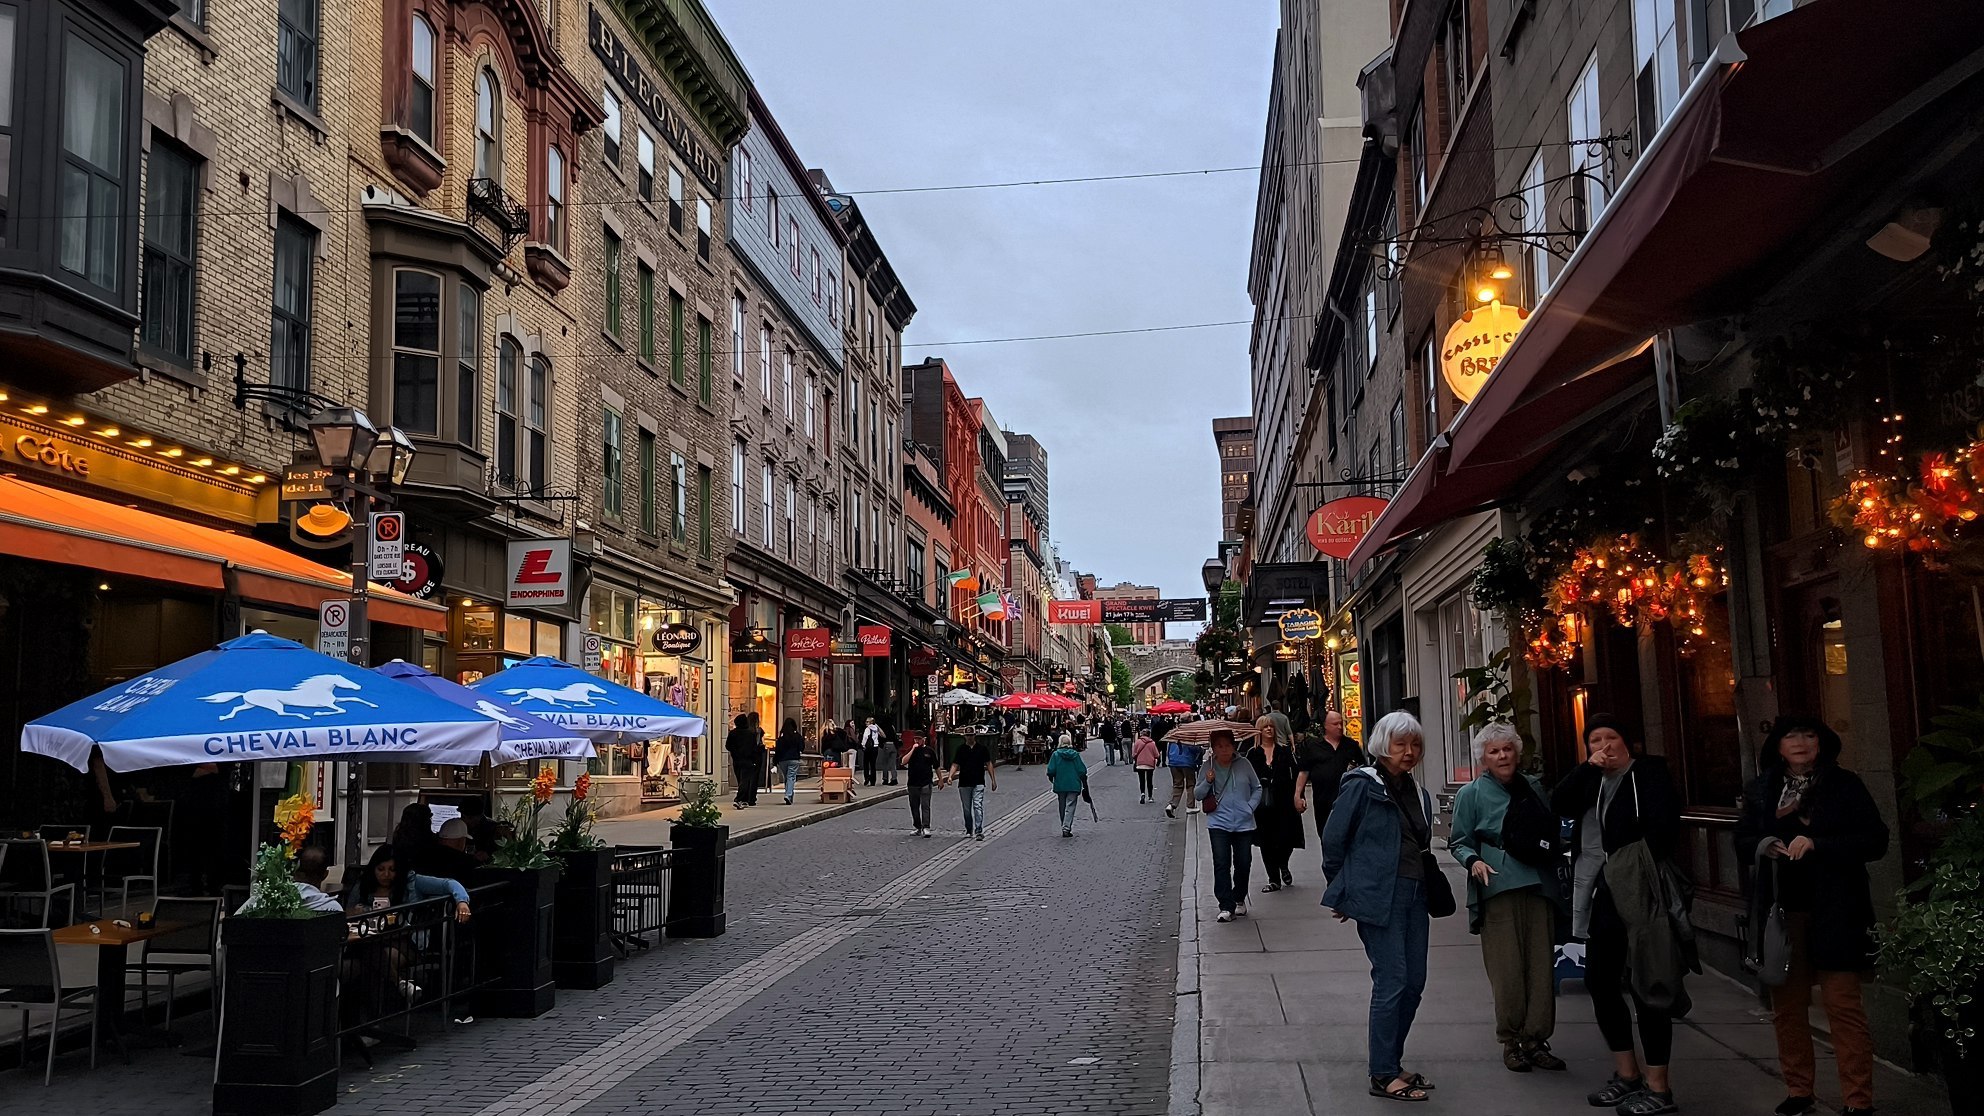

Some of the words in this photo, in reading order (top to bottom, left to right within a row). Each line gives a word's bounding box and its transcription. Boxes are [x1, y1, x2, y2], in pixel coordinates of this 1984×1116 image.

[16, 434, 90, 475] Côte
[286, 484, 305, 493] de
[308, 483, 323, 492] la
[656, 631, 697, 641] LÉONARD
[586, 714, 648, 729] BLANC
[204, 730, 316, 756] CHEVAL
[328, 727, 418, 747] BLANC
[514, 741, 548, 758] CHEVAL
[549, 741, 571, 755] BLANC
